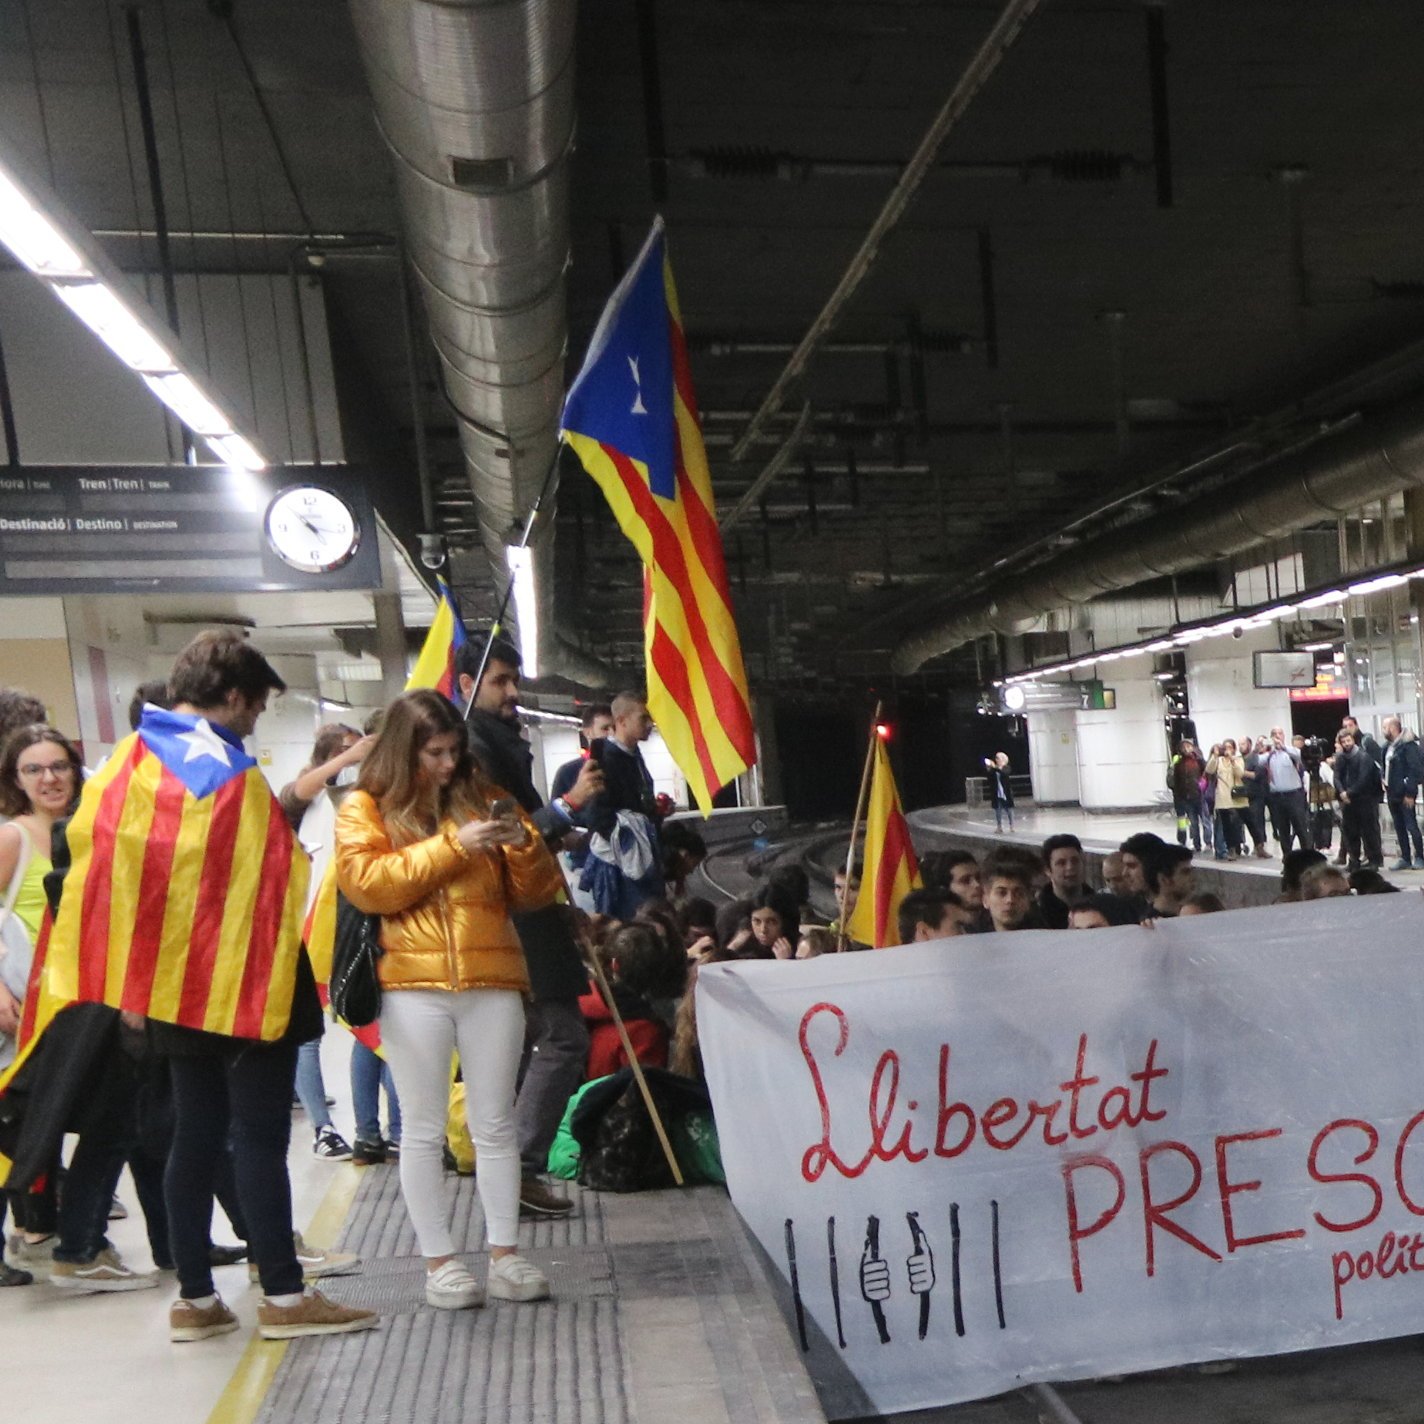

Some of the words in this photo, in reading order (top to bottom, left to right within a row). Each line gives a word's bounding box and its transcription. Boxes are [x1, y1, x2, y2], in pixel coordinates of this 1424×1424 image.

[79, 478, 107, 490] Tren
[112, 478, 139, 490] Tren
[0, 517, 66, 530] Destinació
[76, 518, 122, 530] Destino
[798, 1002, 1170, 1183] Llibertat
